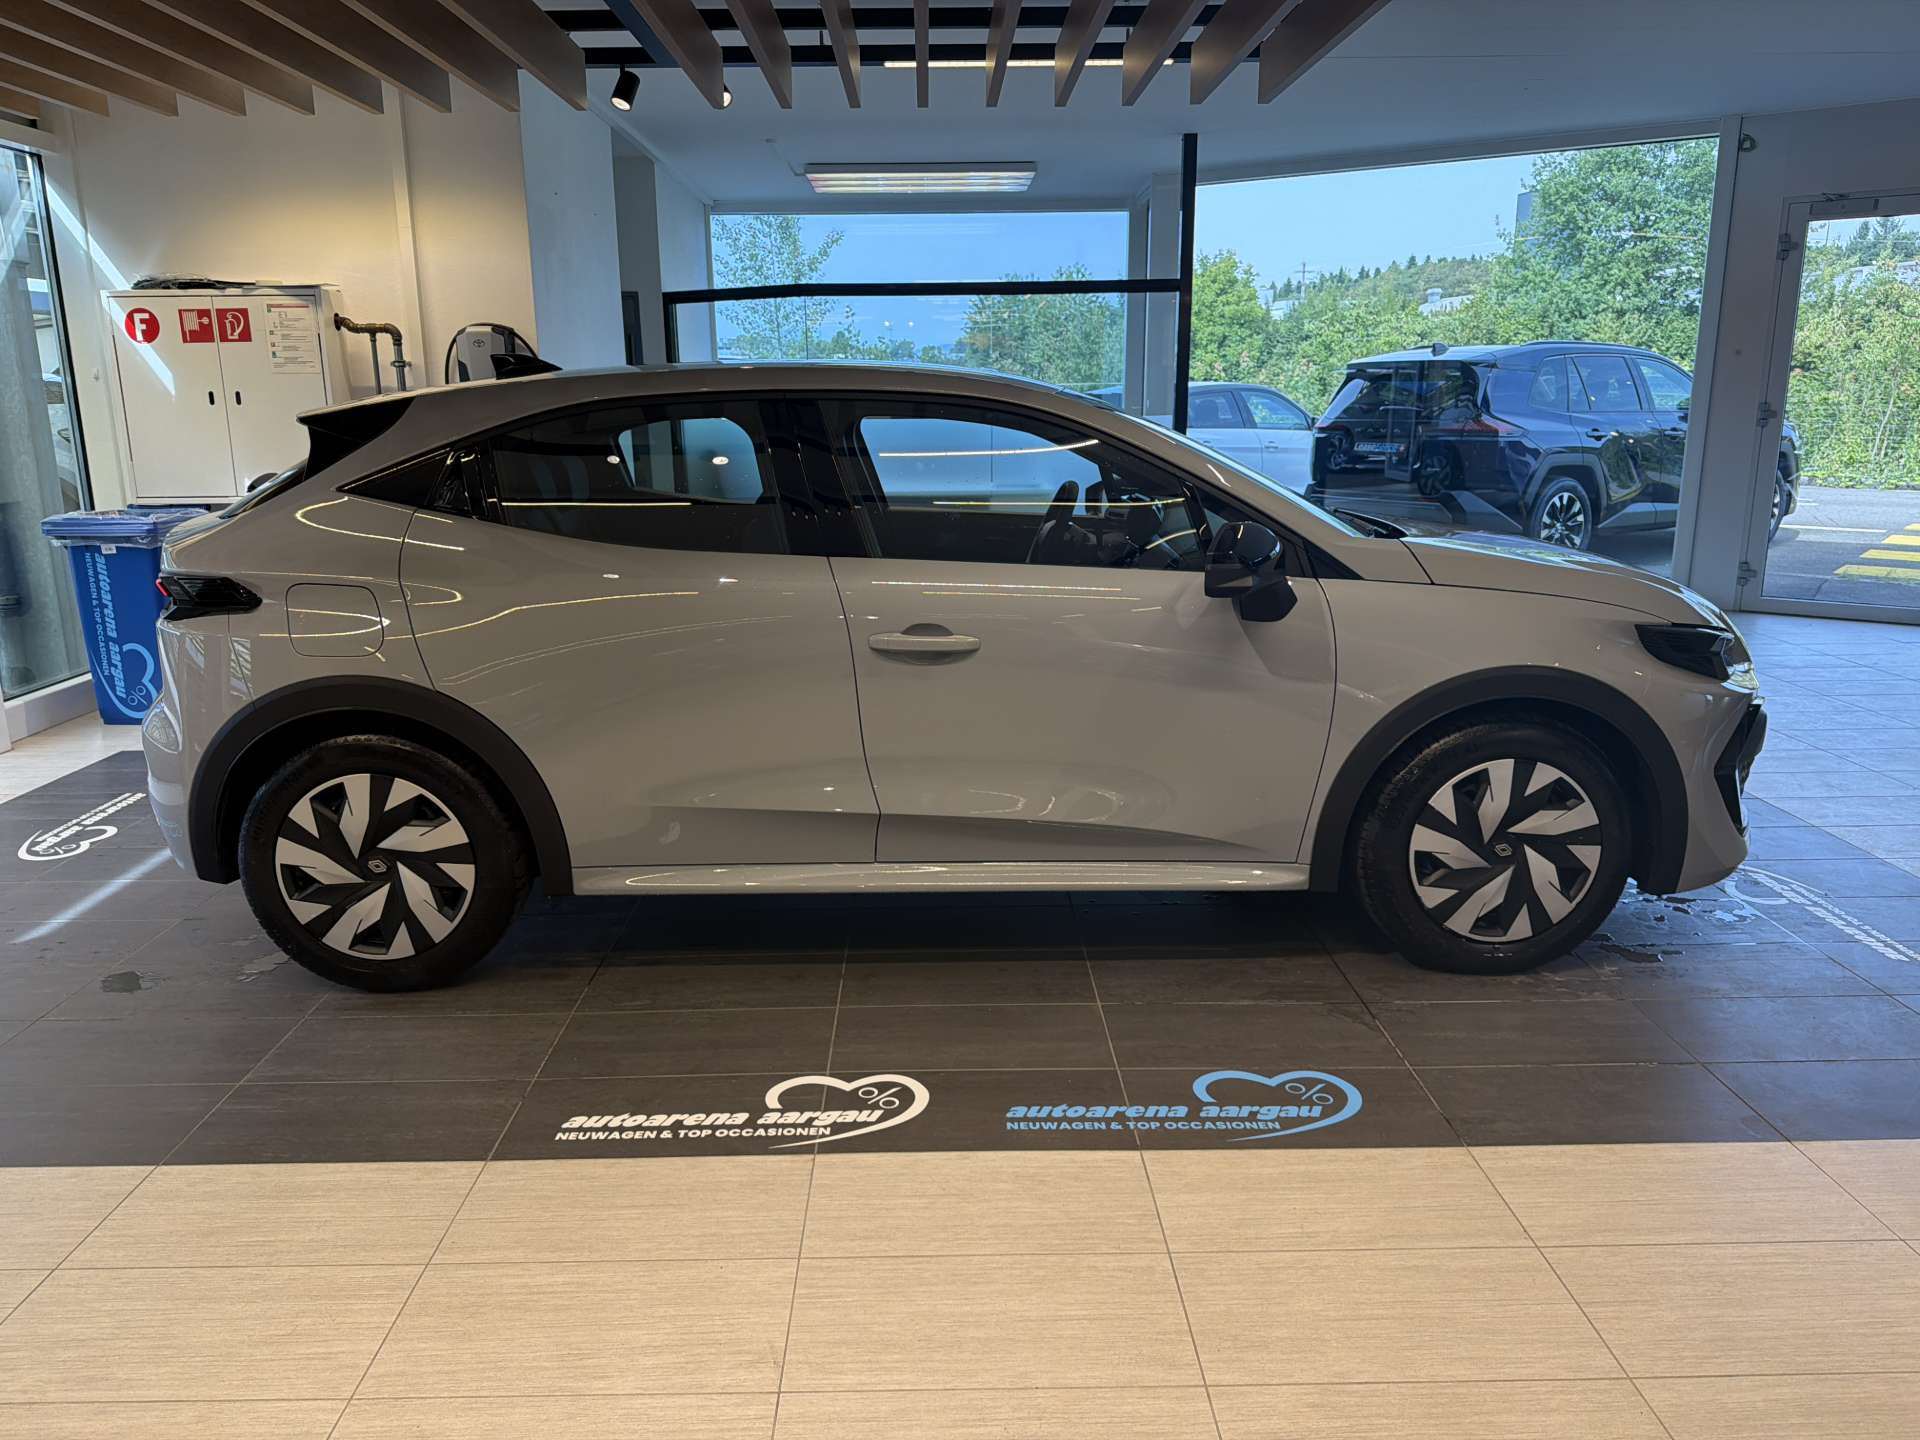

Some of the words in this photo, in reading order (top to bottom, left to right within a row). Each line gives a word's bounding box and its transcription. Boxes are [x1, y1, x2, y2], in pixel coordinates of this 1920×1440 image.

[133, 313, 150, 341] F
[84, 553, 96, 599] NEUWAGEN
[95, 553, 118, 639] autoarena
[109, 641, 126, 698] aargau
[561, 1111, 749, 1129] autoarena
[757, 1108, 884, 1127] aargau
[1006, 1104, 1189, 1118] autoarena
[1200, 1104, 1322, 1120] aargau
[555, 1130, 657, 1141] NEUWAGEN
[660, 1130, 673, 1139] &
[679, 1129, 713, 1138] TOP
[716, 1126, 831, 1138] OCCASIONEN
[1006, 1122, 1108, 1130] NEUWAGEN
[1111, 1121, 1124, 1130] &
[1128, 1121, 1161, 1130] TOP
[1164, 1120, 1281, 1130] OCCASIONEN
